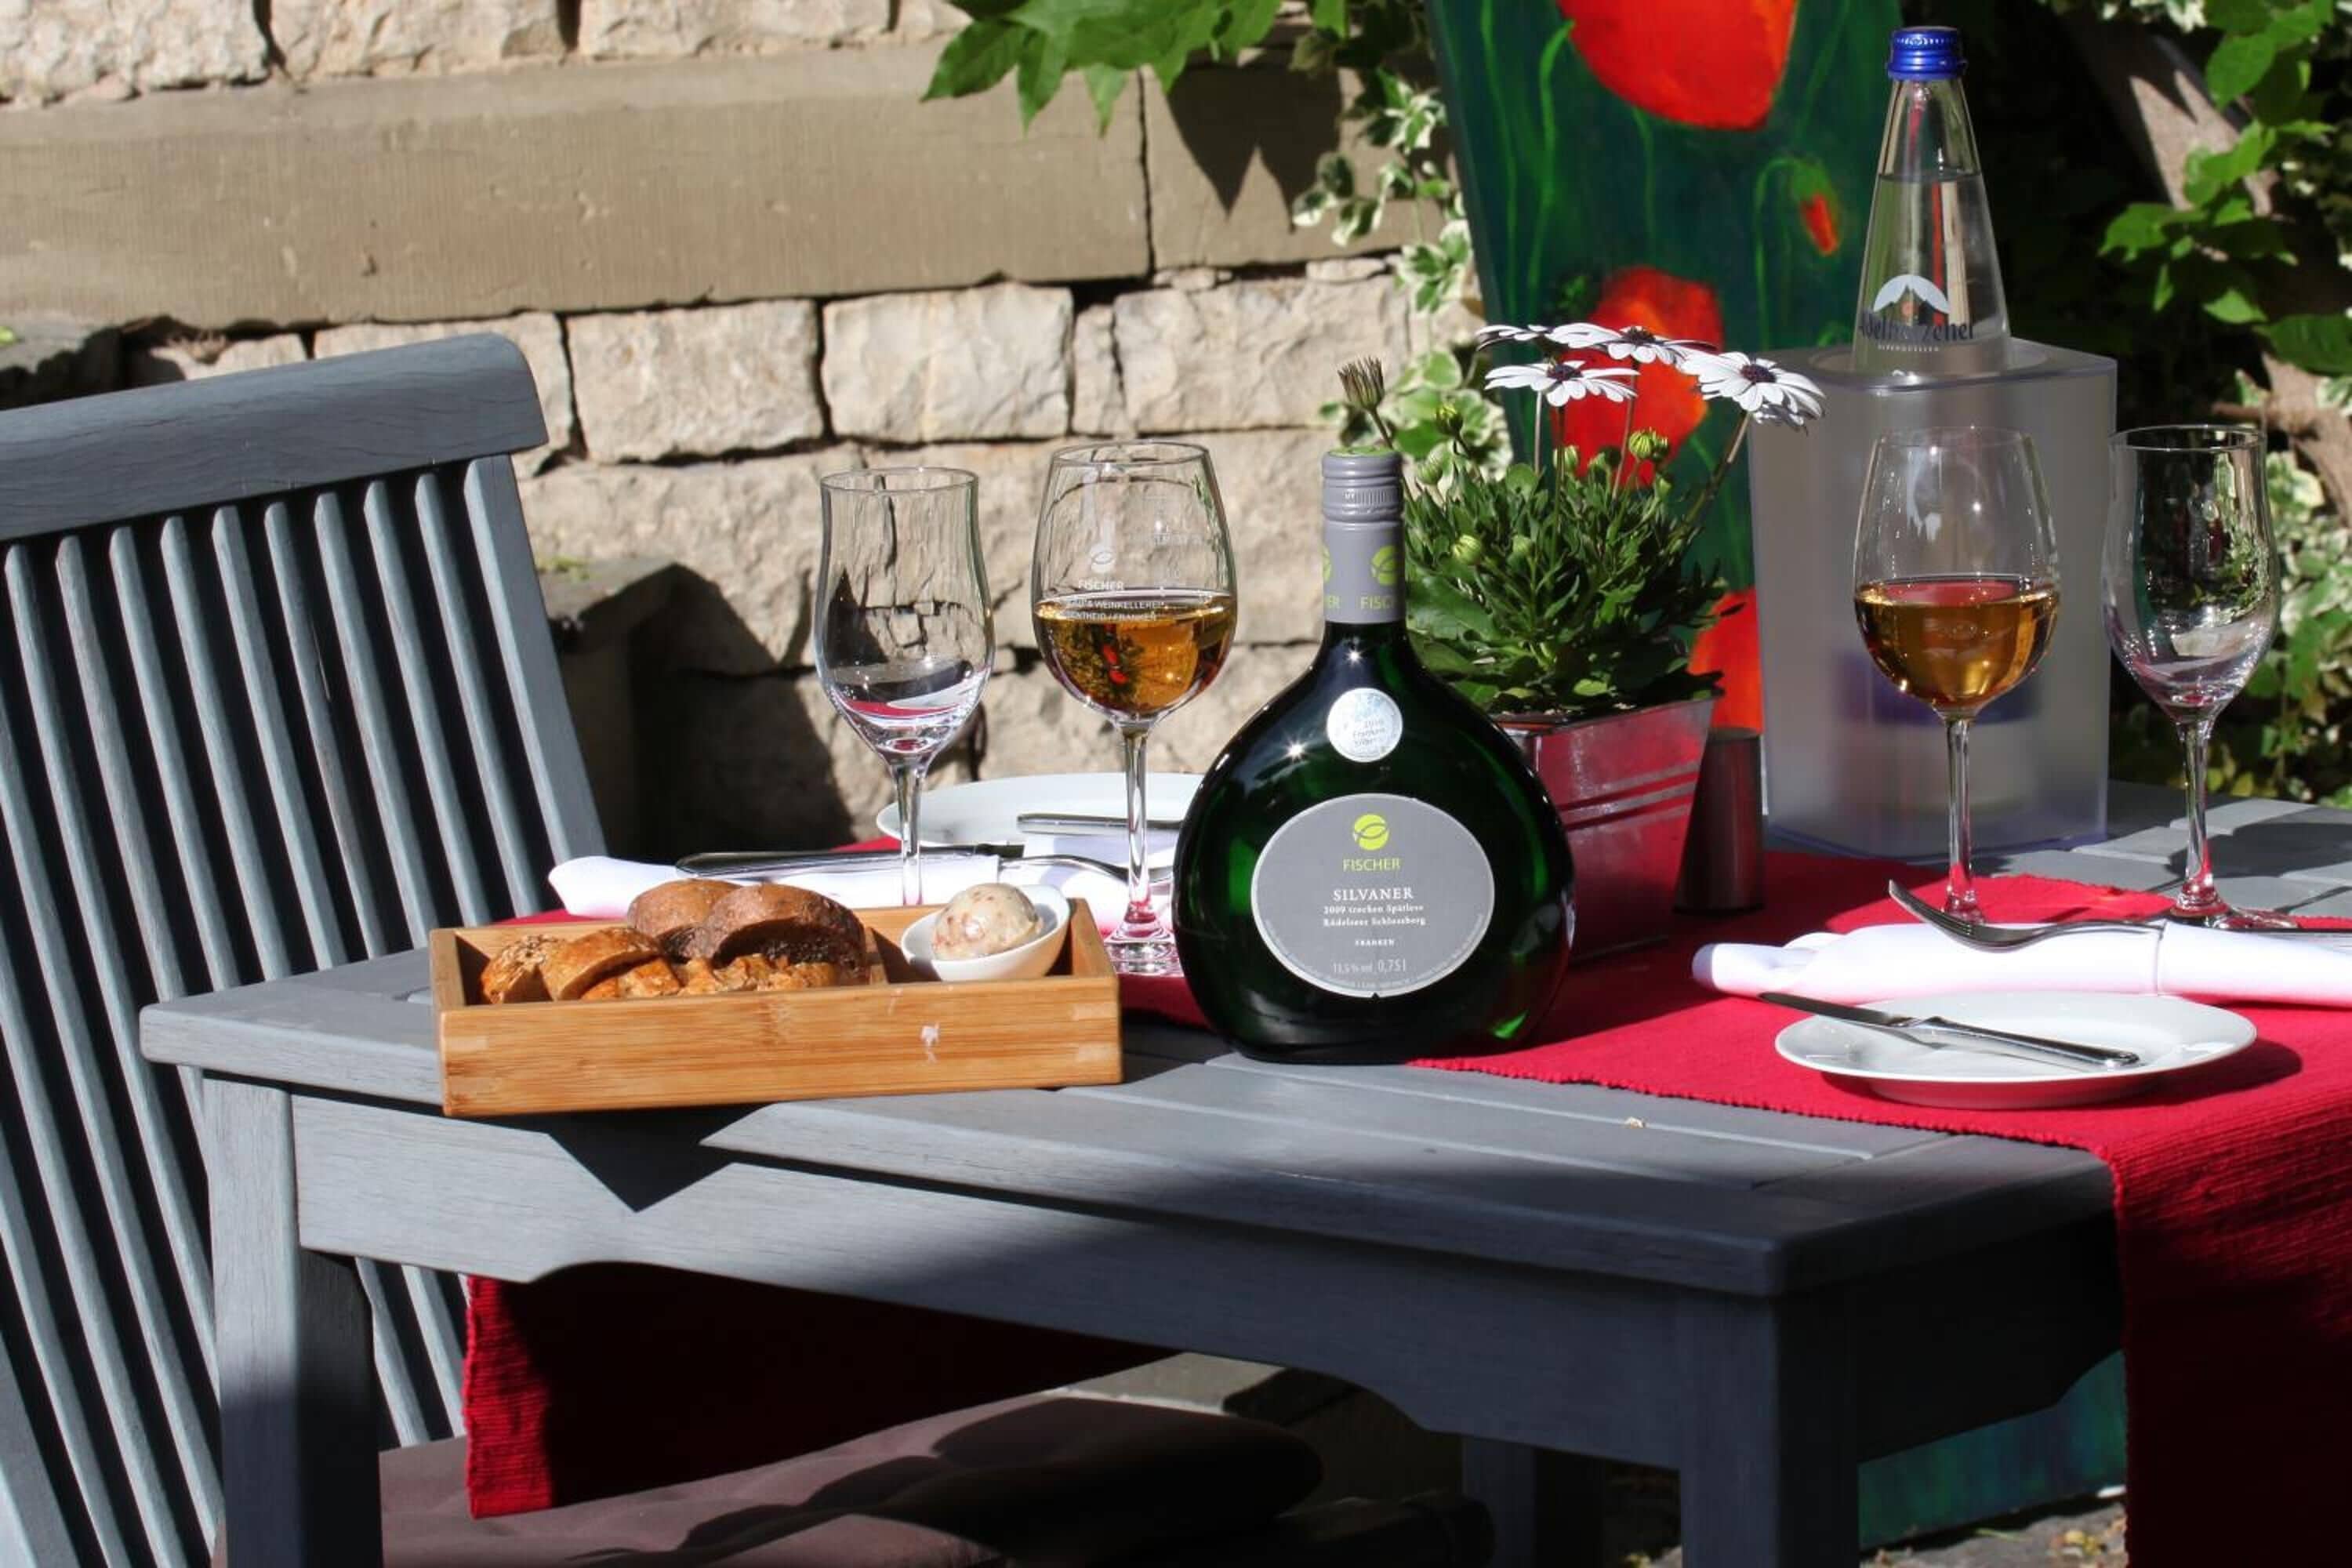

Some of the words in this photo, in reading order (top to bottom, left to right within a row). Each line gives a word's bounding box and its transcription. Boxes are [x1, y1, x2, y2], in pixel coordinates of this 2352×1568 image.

[1078, 579, 1124, 590] FISCHER
[1342, 858, 1400, 872] FISCHER
[1333, 887, 1414, 902] SILVANER
[1323, 905, 1346, 915] 2009
[1348, 904, 1384, 914] trocken
